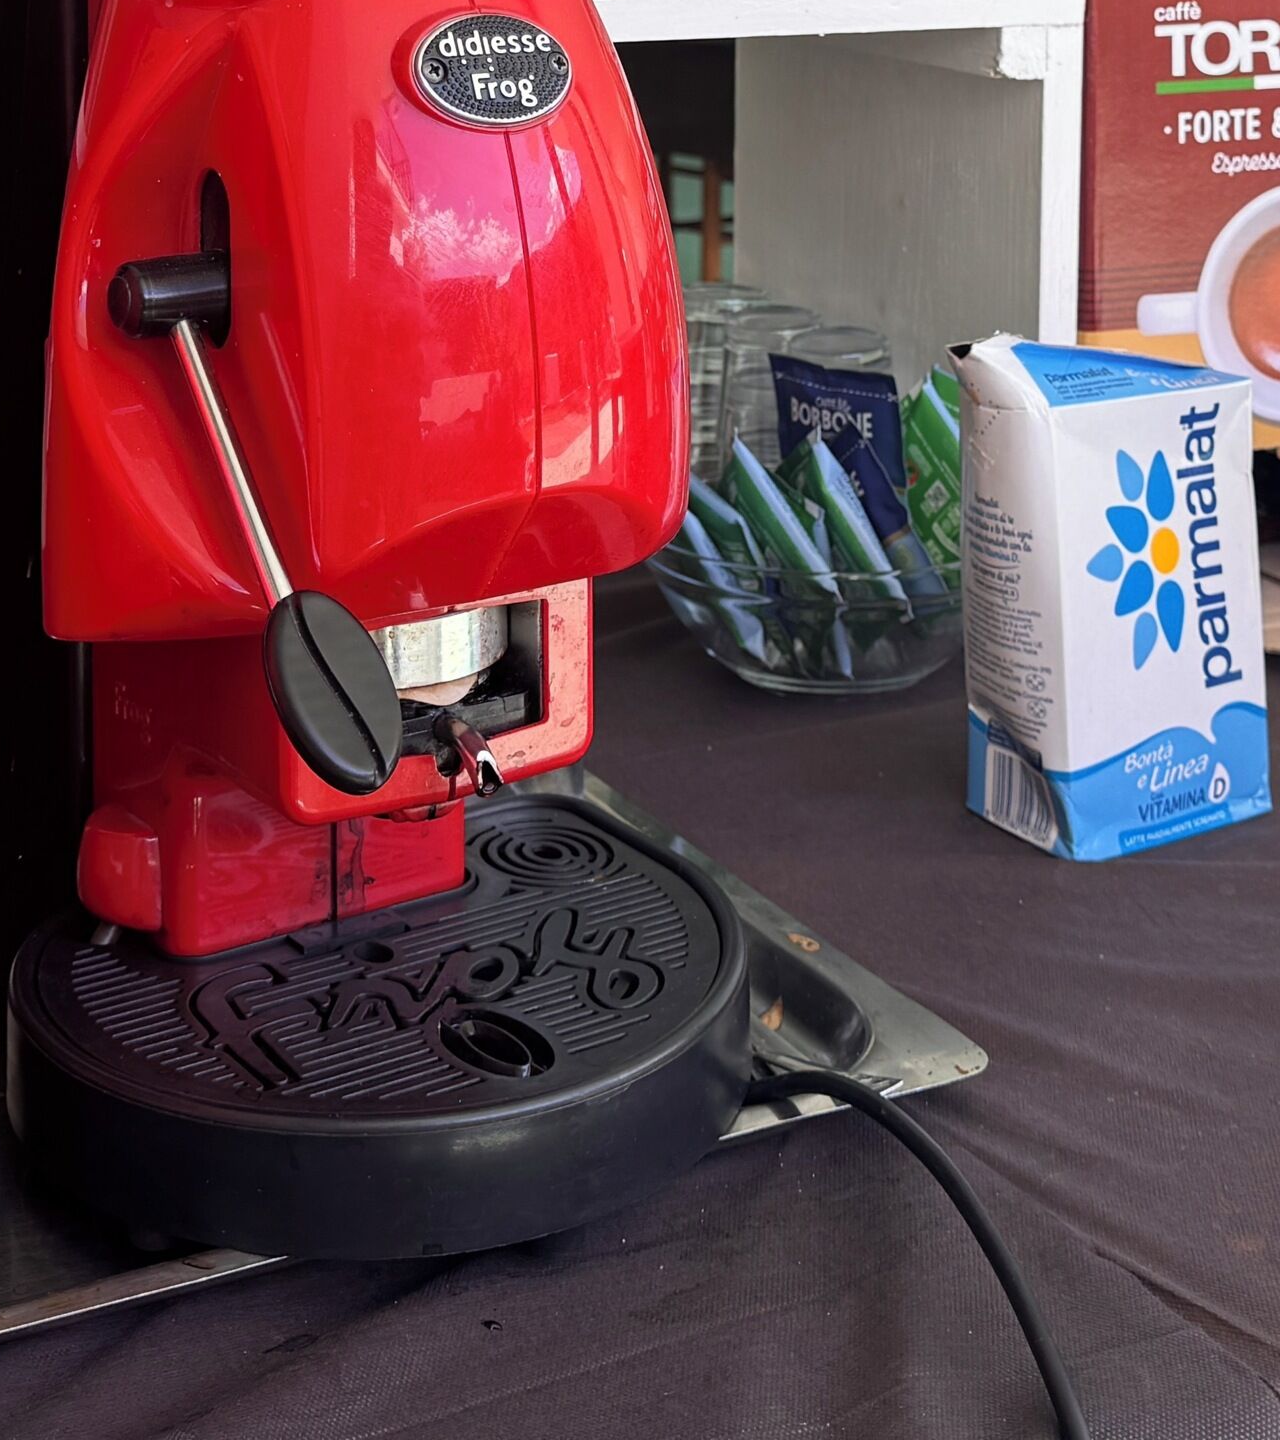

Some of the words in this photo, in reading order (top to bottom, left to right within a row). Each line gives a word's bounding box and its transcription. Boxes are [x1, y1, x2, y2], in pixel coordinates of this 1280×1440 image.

[1154, 0, 1202, 22] caffè
[438, 30, 552, 62] didiesse
[471, 72, 539, 107] Frog
[1177, 107, 1262, 144] FORTE
[1176, 402, 1243, 689] parmalat
[1124, 740, 1174, 773] Bontà
[1137, 773, 1148, 790] e
[1150, 753, 1209, 792] Linea
[1138, 787, 1206, 822] VITAMINA
[1213, 777, 1227, 800] D
